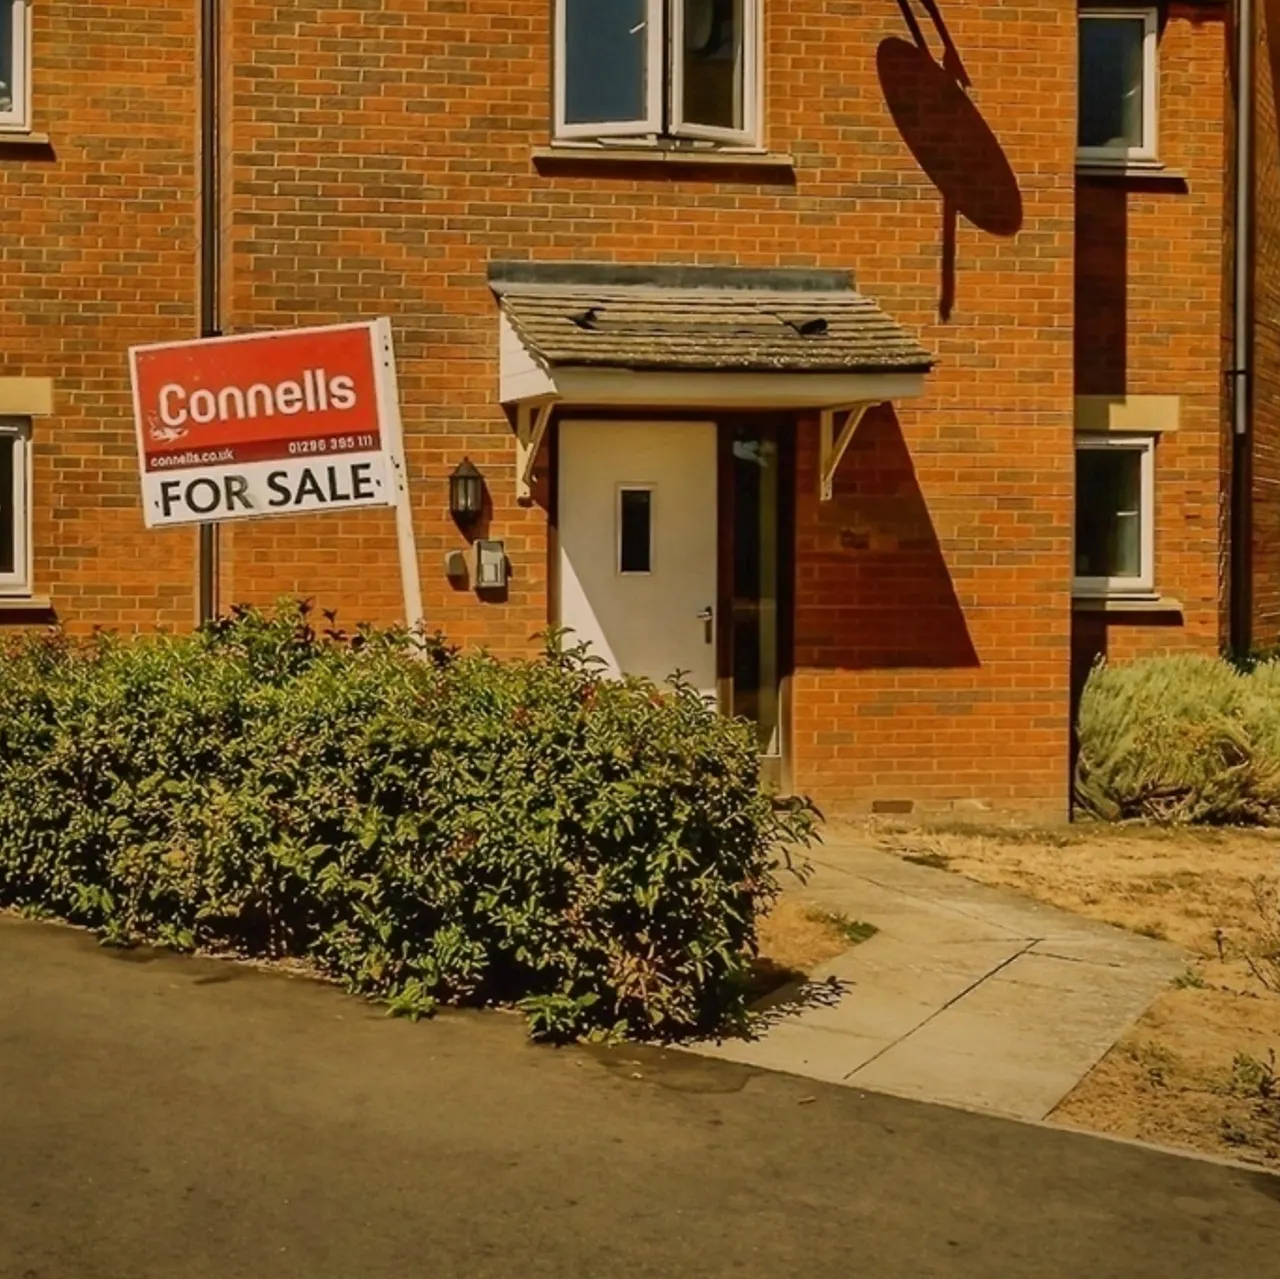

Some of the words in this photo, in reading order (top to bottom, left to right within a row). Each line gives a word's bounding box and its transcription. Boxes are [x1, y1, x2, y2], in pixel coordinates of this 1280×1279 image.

[158, 368, 357, 426] Connells
[150, 449, 235, 468] connells.co.uk
[160, 476, 254, 517] FOR
[267, 463, 375, 507] SALE
